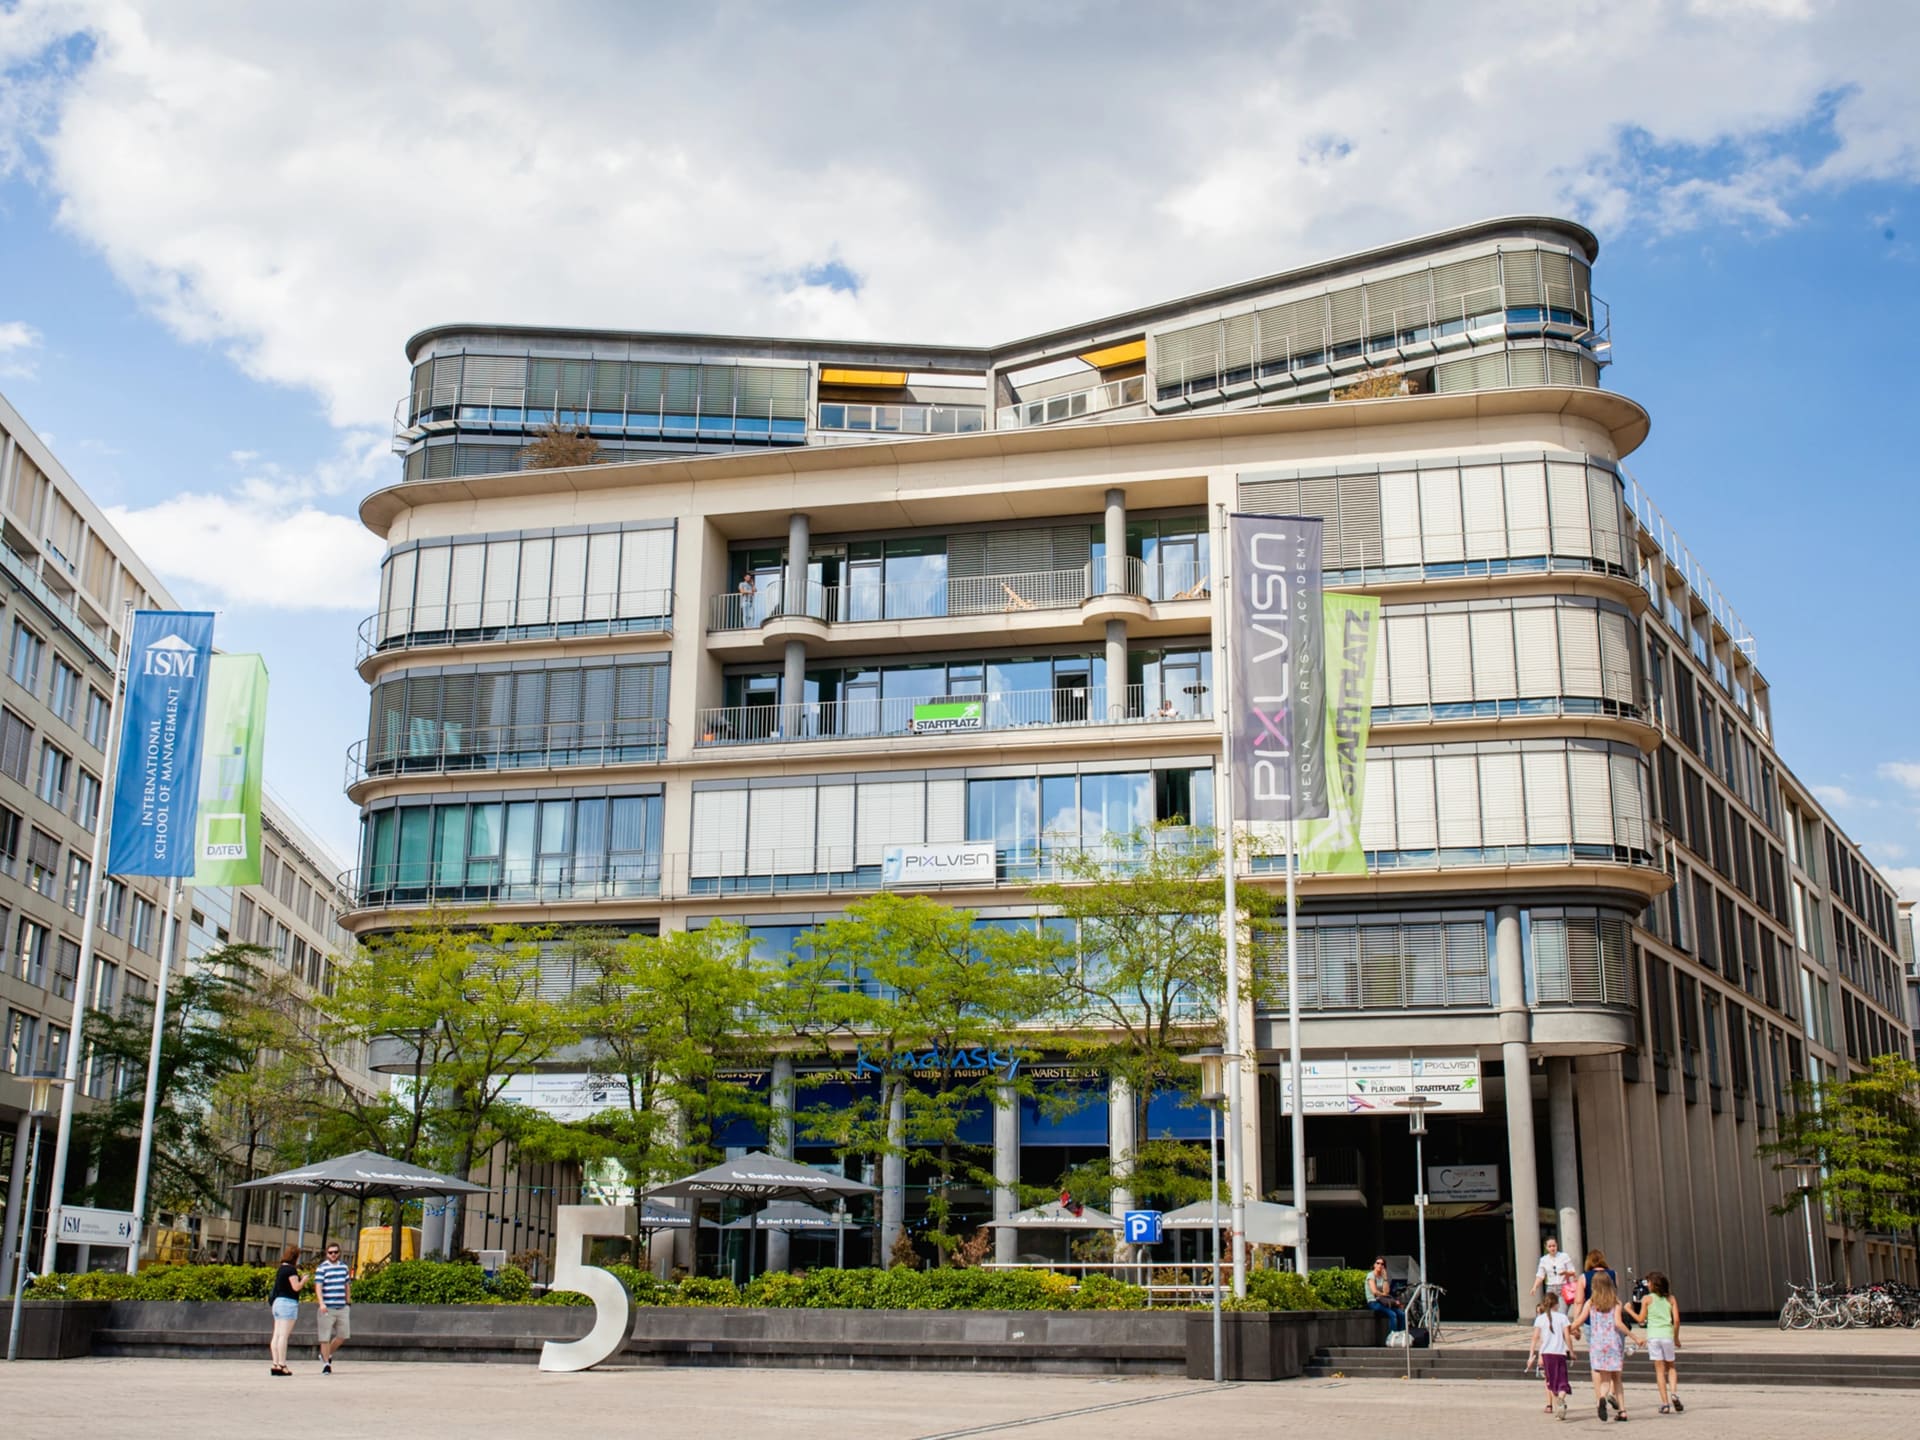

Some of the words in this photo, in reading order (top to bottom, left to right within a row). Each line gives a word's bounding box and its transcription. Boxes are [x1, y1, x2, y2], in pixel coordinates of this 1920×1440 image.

[1296, 534, 1308, 623] ACADEMY
[143, 650, 198, 679] ISM
[1299, 653, 1311, 705] ARTS
[1335, 608, 1371, 797] STARTPLATZ
[163, 686, 180, 782] MANAGEMENT
[916, 718, 979, 730] STARTPLATZ
[141, 718, 162, 827] INTERNATIONAL
[1302, 740, 1312, 801] MEDIA
[159, 784, 171, 803] OF
[153, 803, 169, 860] SCHOOL
[206, 844, 243, 857] DATEV
[1285, 1100, 1345, 1109] NOGYM
[1415, 1083, 1461, 1093] STARTPLATZ
[63, 1216, 81, 1233] ISM
[1132, 1223, 1148, 1241] P
[538, 1204, 638, 1372] 5
